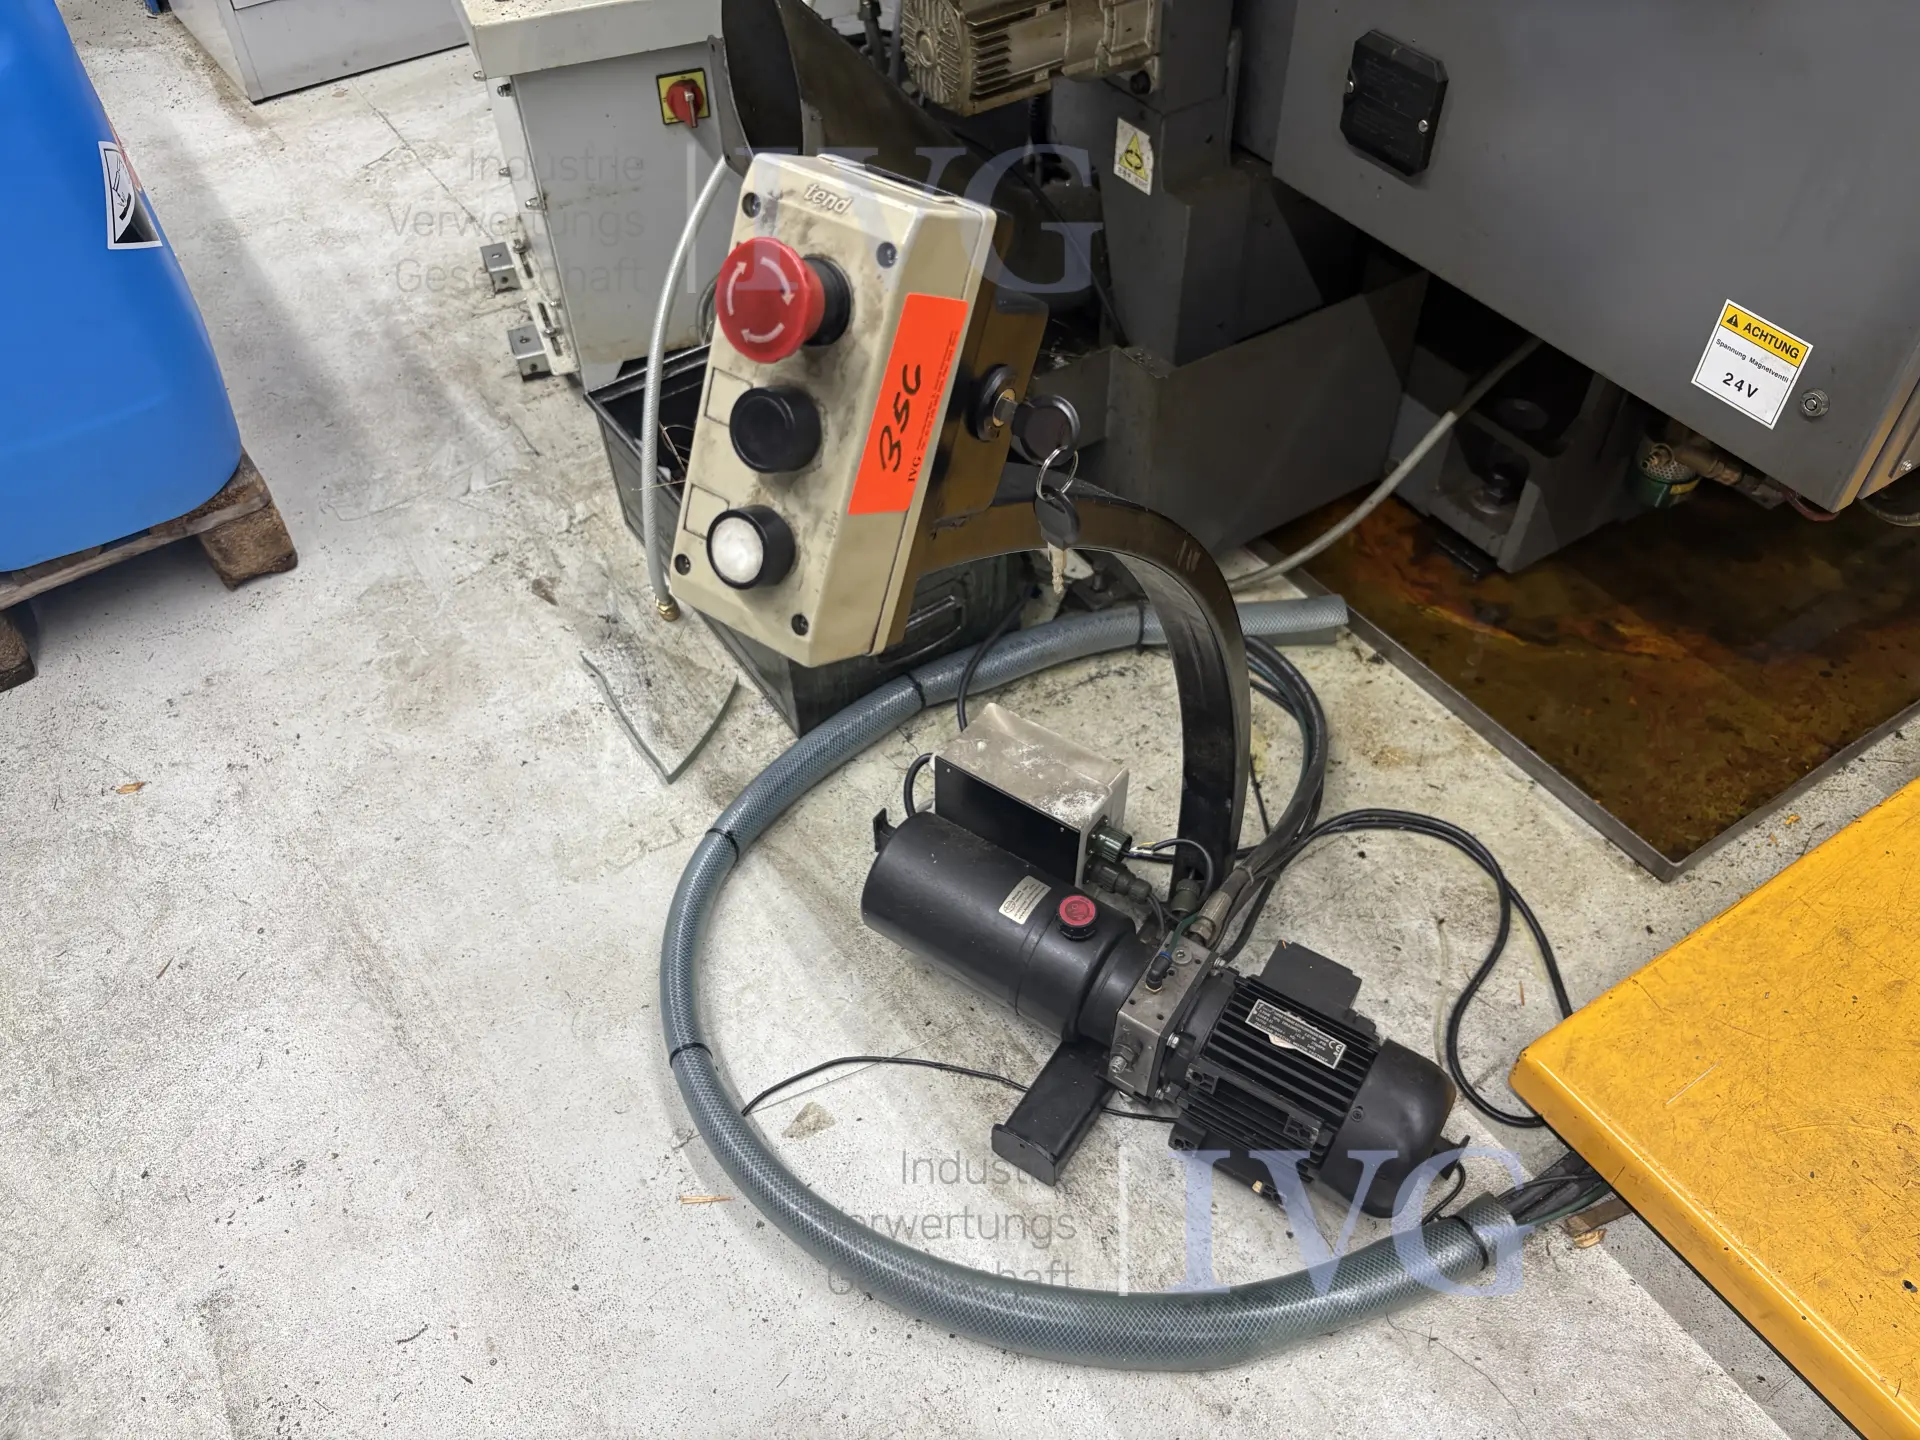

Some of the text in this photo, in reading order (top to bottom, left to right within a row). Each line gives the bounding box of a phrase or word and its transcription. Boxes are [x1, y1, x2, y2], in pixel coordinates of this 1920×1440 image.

[804, 182, 852, 214] tend
[1743, 322, 1800, 360] ACHTUNG
[1715, 338, 1789, 384] Spannung Magnetventil
[1722, 371, 1759, 399] 24V
[907, 456, 923, 483] IVG
